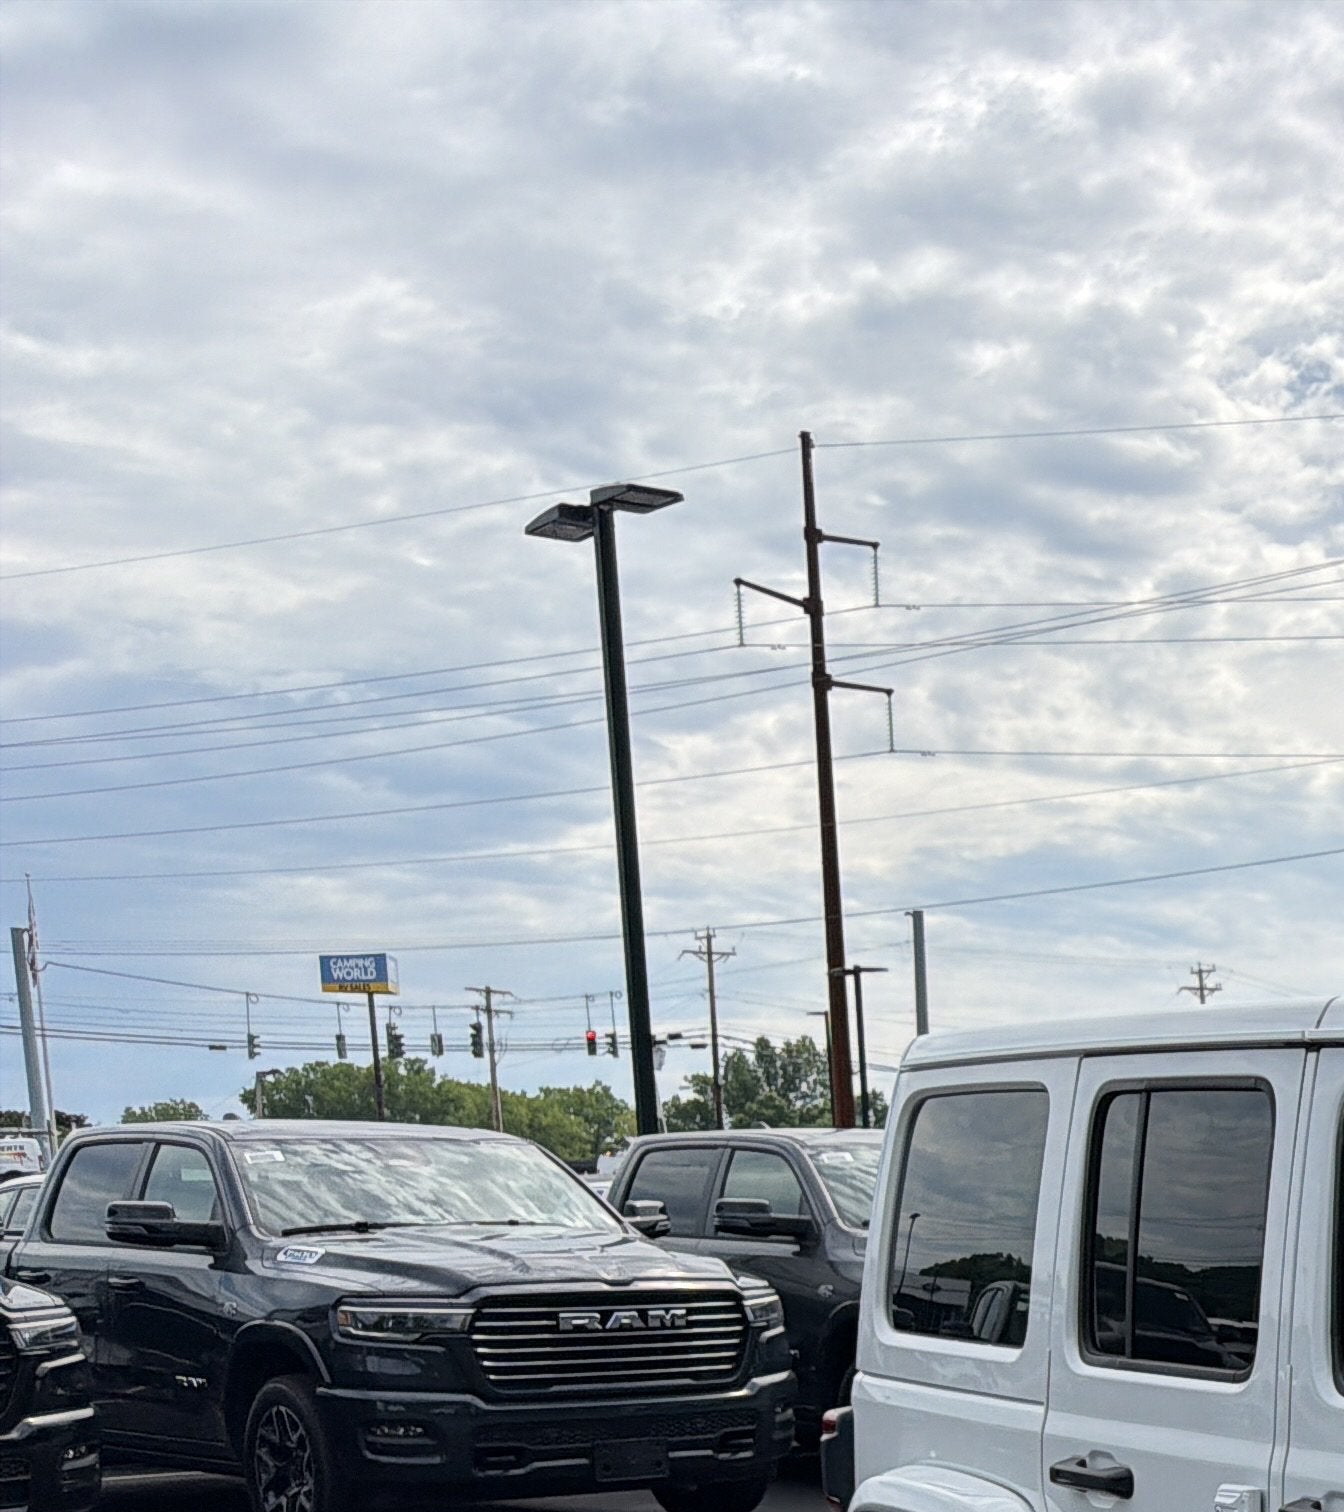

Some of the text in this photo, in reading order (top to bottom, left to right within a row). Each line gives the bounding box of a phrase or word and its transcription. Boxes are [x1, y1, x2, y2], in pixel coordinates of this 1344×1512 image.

[330, 957, 376, 968] CAMPING
[331, 968, 377, 980] WORLD
[559, 1309, 687, 1330] RAM
